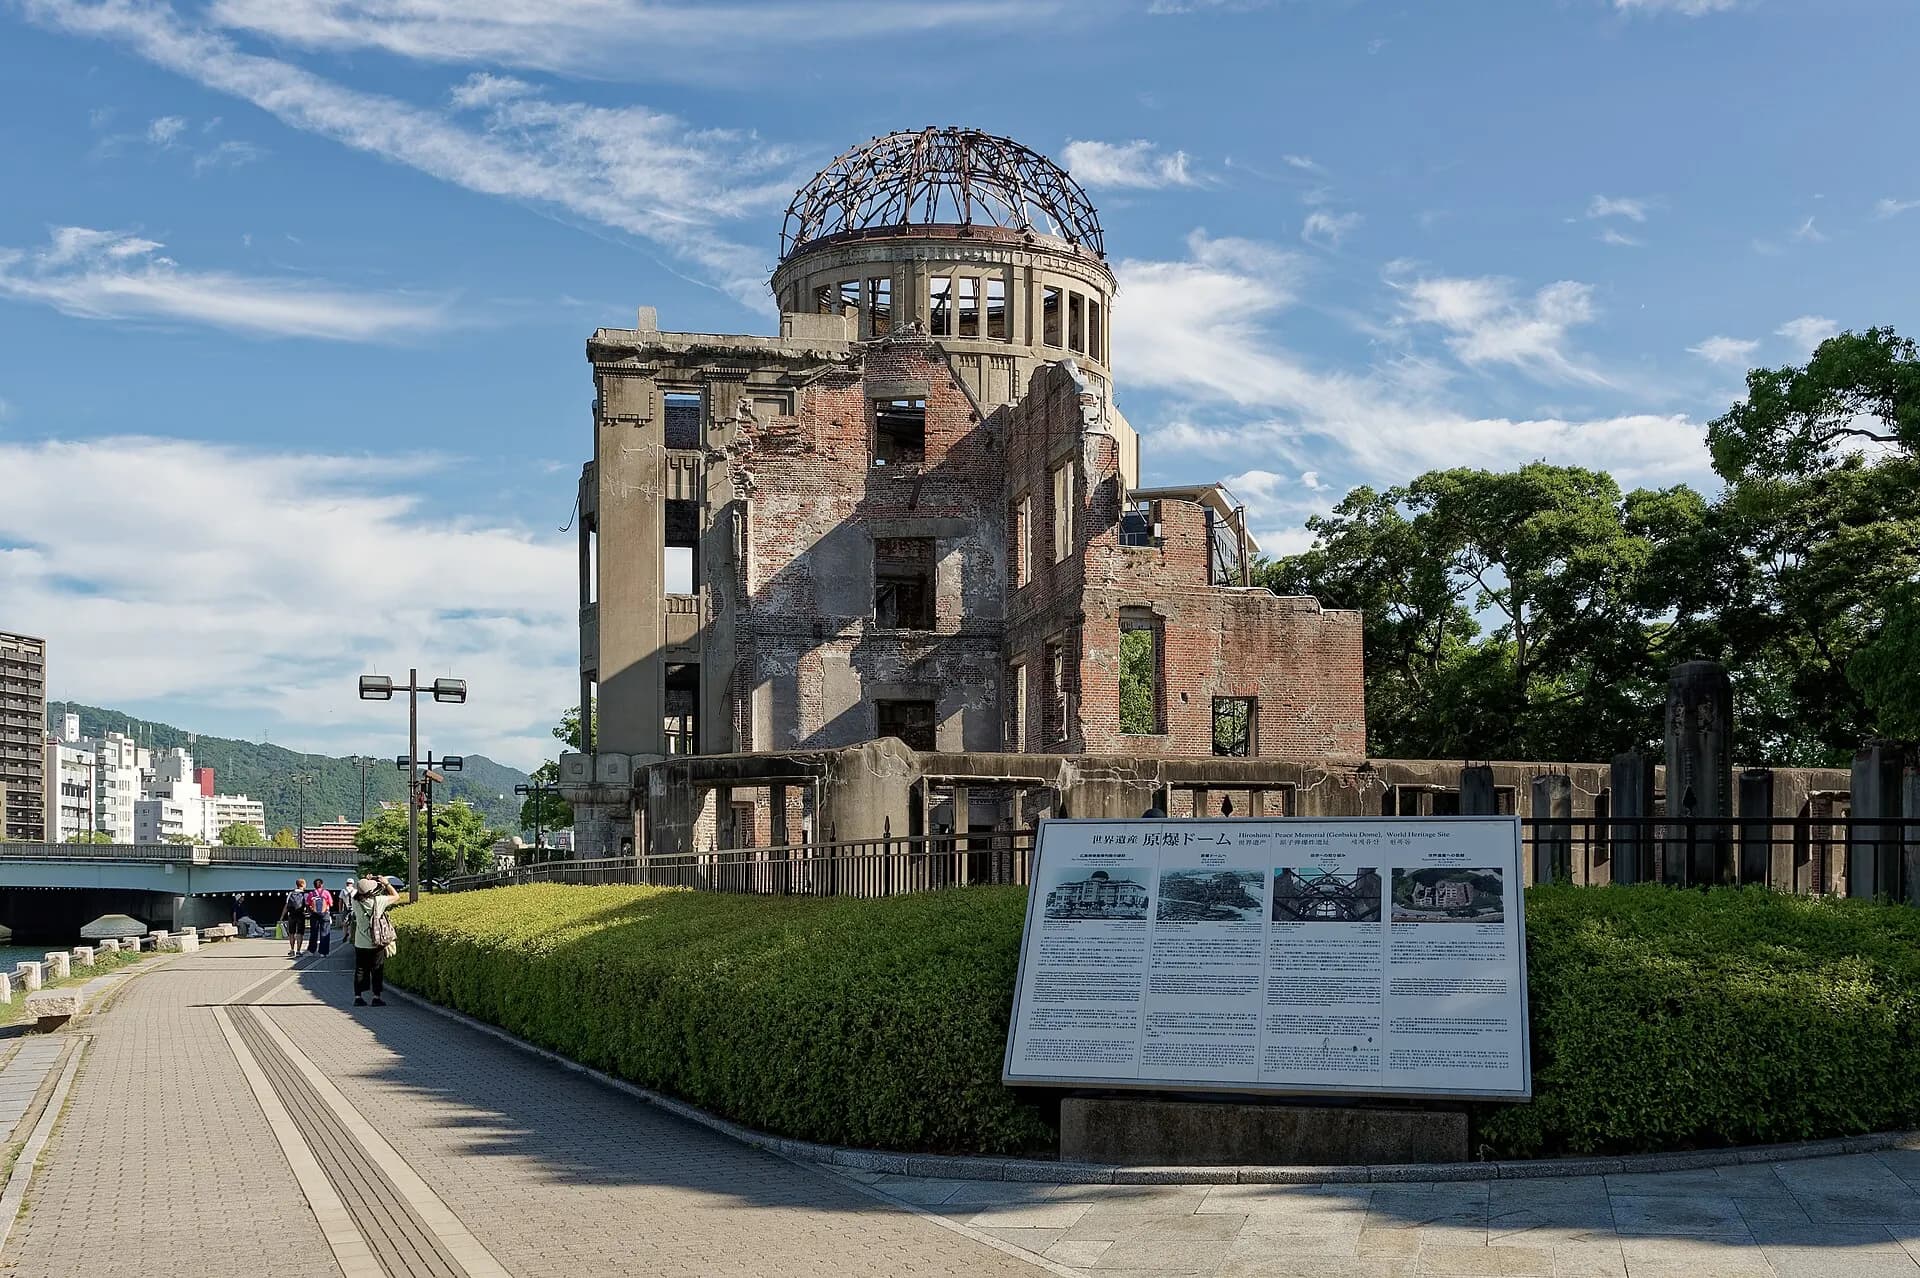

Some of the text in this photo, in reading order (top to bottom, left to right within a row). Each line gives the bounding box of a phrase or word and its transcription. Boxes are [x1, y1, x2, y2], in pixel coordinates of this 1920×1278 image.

[1092, 832, 1232, 846] 世界遺産 原爆ドーム
